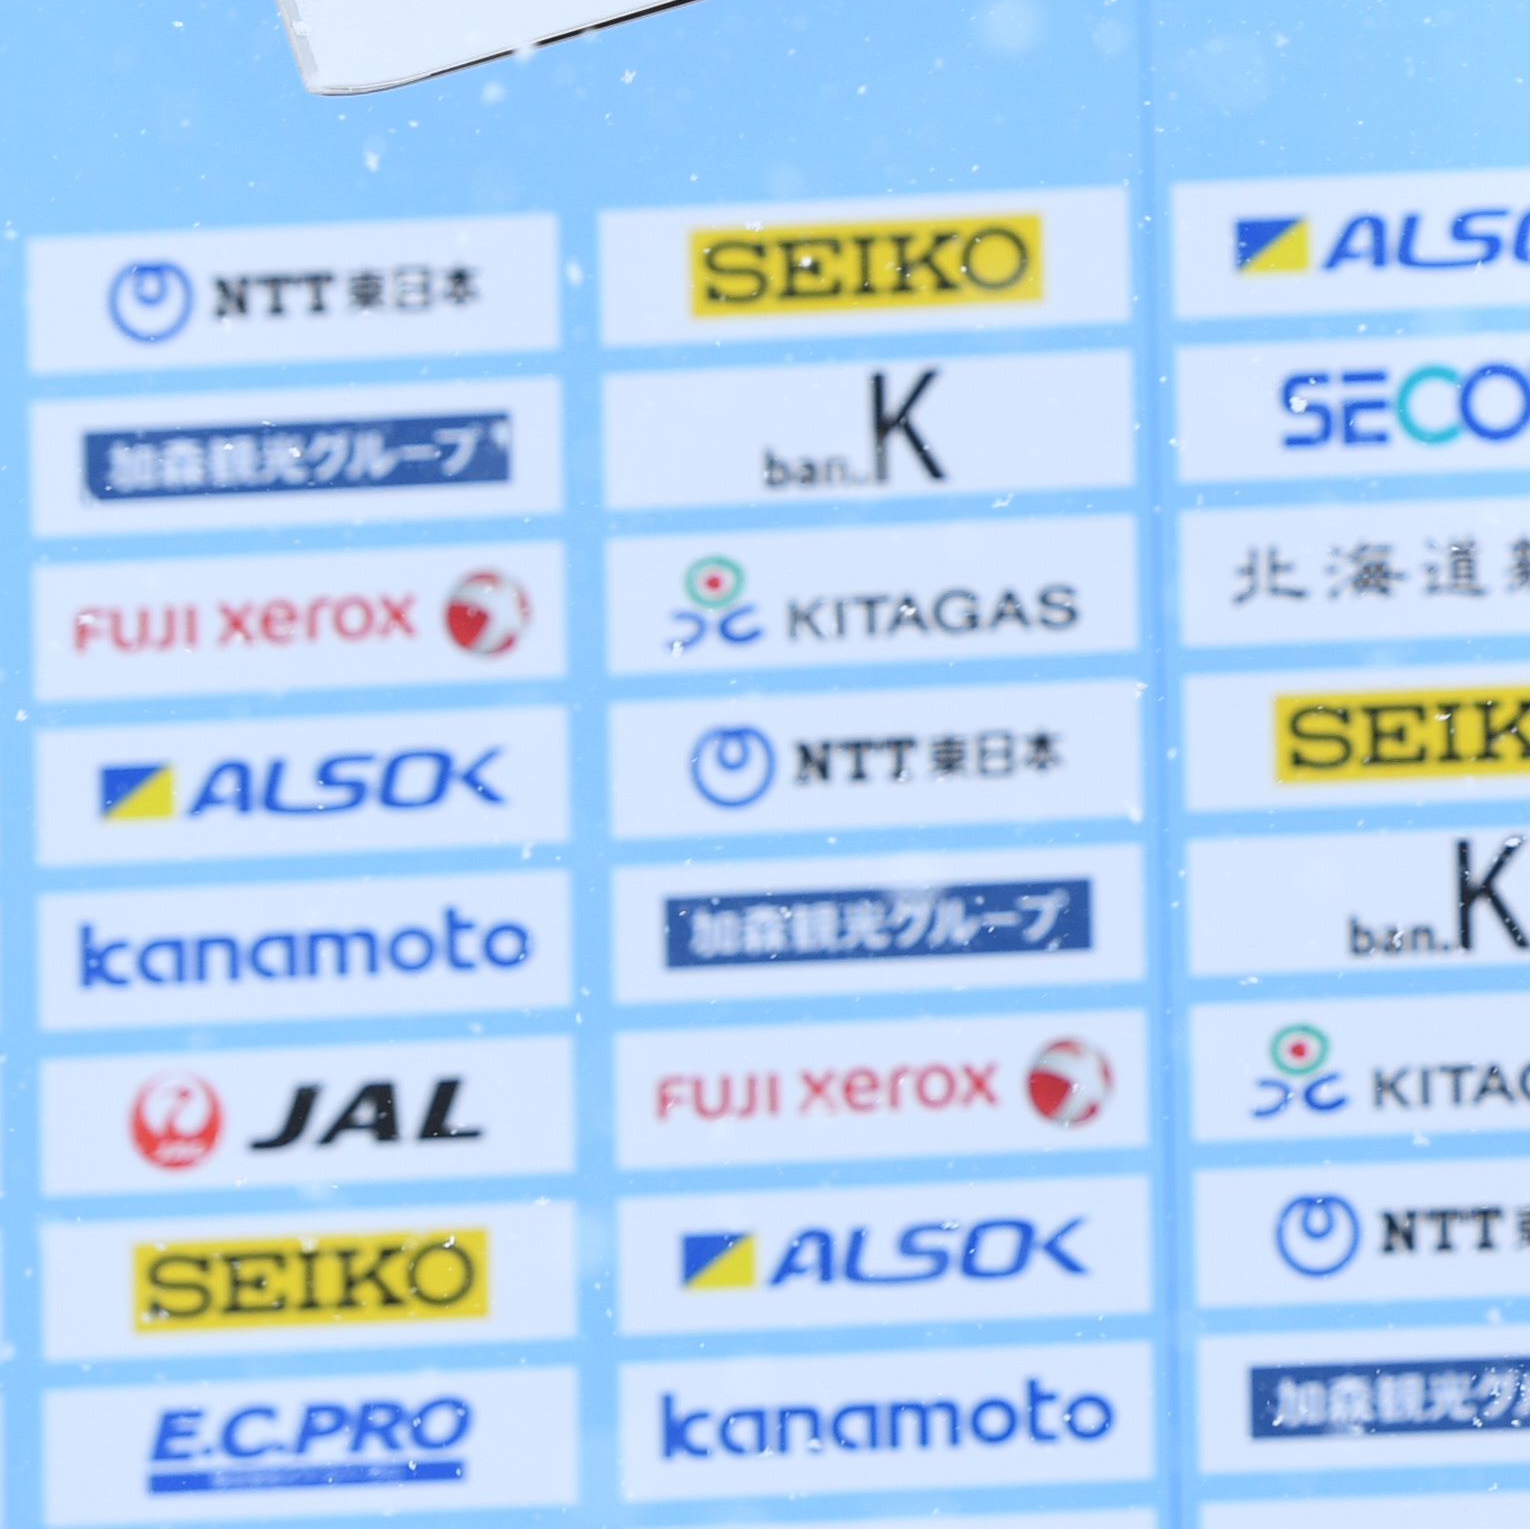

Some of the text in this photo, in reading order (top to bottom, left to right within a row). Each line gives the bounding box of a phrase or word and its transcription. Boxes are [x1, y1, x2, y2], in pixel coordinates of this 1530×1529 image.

[213, 266, 477, 319] NTT東日本
[703, 227, 1029, 305] SEIKO
[104, 419, 508, 494] 加森観光グループ
[73, 592, 418, 654] FUJI xerox
[787, 584, 1080, 639] KITAGAS
[187, 748, 505, 818] ALSOK
[795, 731, 1059, 784] NTT東日本
[78, 906, 532, 990] kanamoto
[691, 885, 1070, 960] 加森観光グループ
[249, 1077, 482, 1152] JAL
[655, 1063, 998, 1121] FUJI xerox
[147, 1241, 476, 1319] SEIKO
[768, 1217, 1087, 1287] ALSOK
[150, 1396, 472, 1462] E.C.PRO
[660, 1377, 1116, 1460] kanamoto
